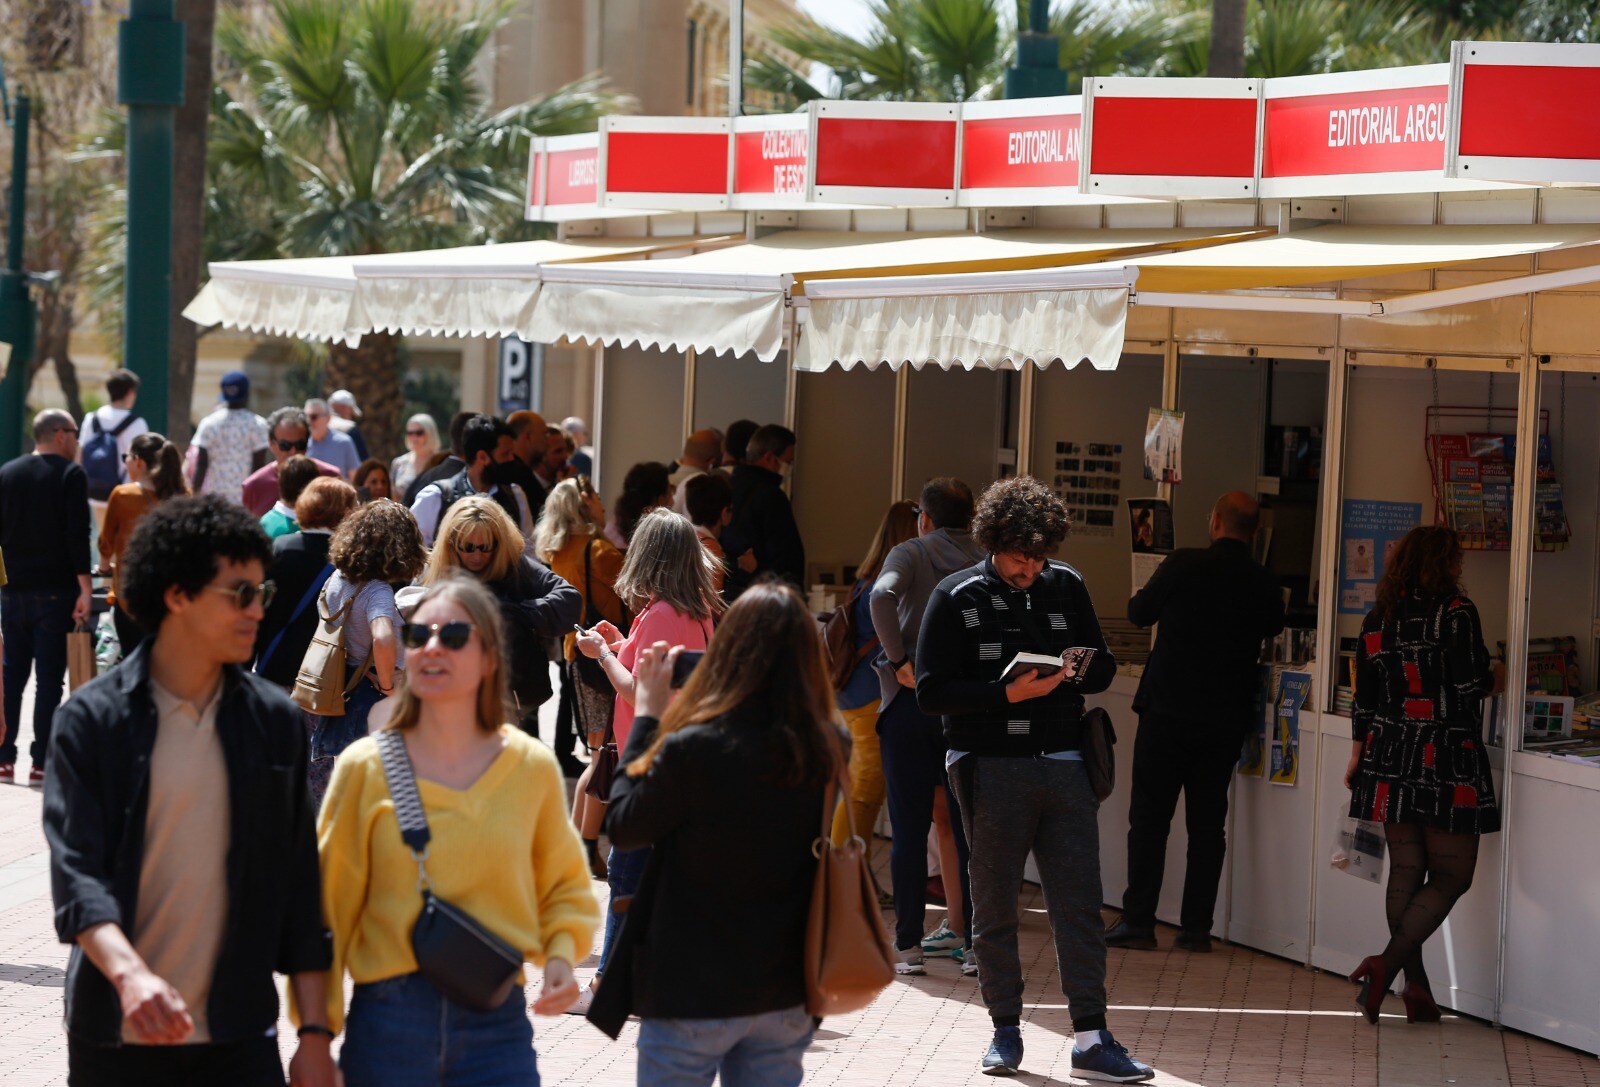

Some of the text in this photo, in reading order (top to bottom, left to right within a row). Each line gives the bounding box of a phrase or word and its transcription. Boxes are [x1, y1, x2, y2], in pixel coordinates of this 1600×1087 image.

[1328, 103, 1448, 147] EDITORIAL ARGU
[1008, 130, 1064, 165] EDITORIAL
[774, 165, 787, 193] DE
[501, 338, 527, 400] P
[1378, 511, 1414, 519] DETALLE
